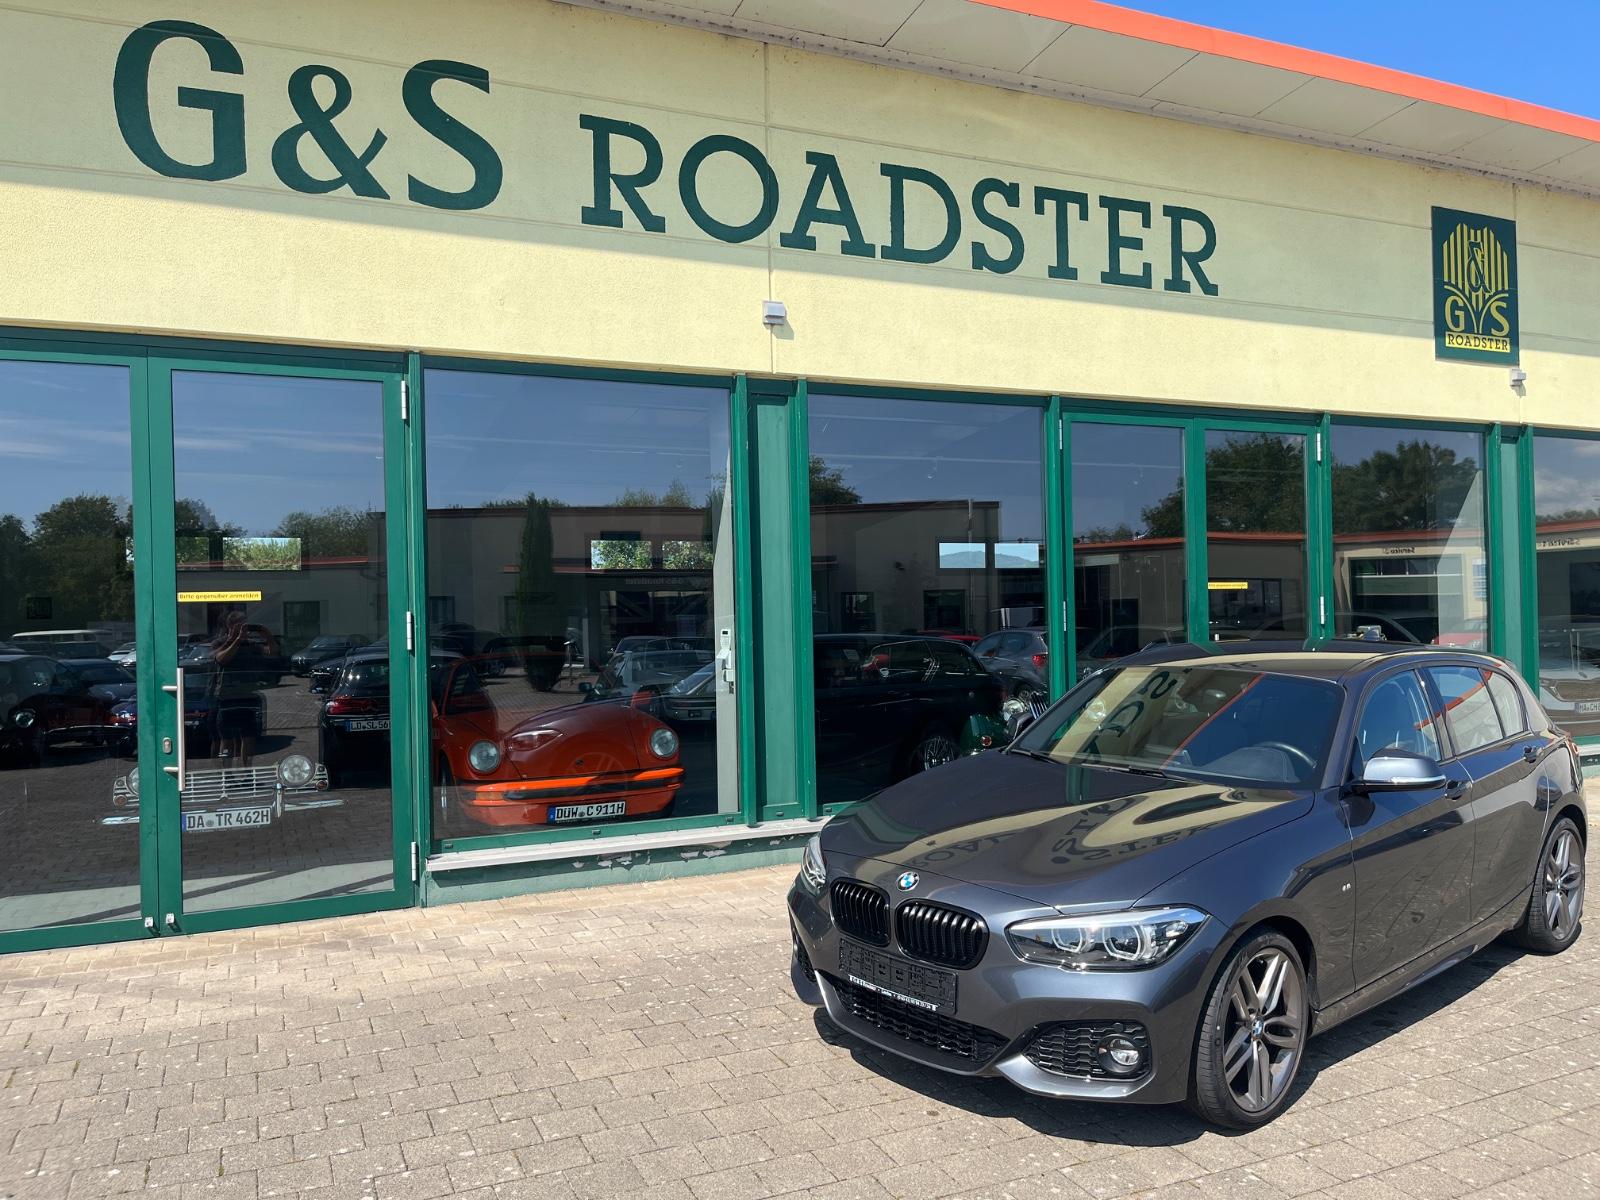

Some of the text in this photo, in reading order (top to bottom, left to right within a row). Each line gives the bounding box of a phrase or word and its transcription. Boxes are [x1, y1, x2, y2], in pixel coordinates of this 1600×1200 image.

[113, 19, 1219, 296] G&S ROADSTER
[1447, 333, 1509, 351] ROADSTER
[187, 810, 269, 829] DA TR 462H
[556, 802, 625, 819] DÜW C 911H
